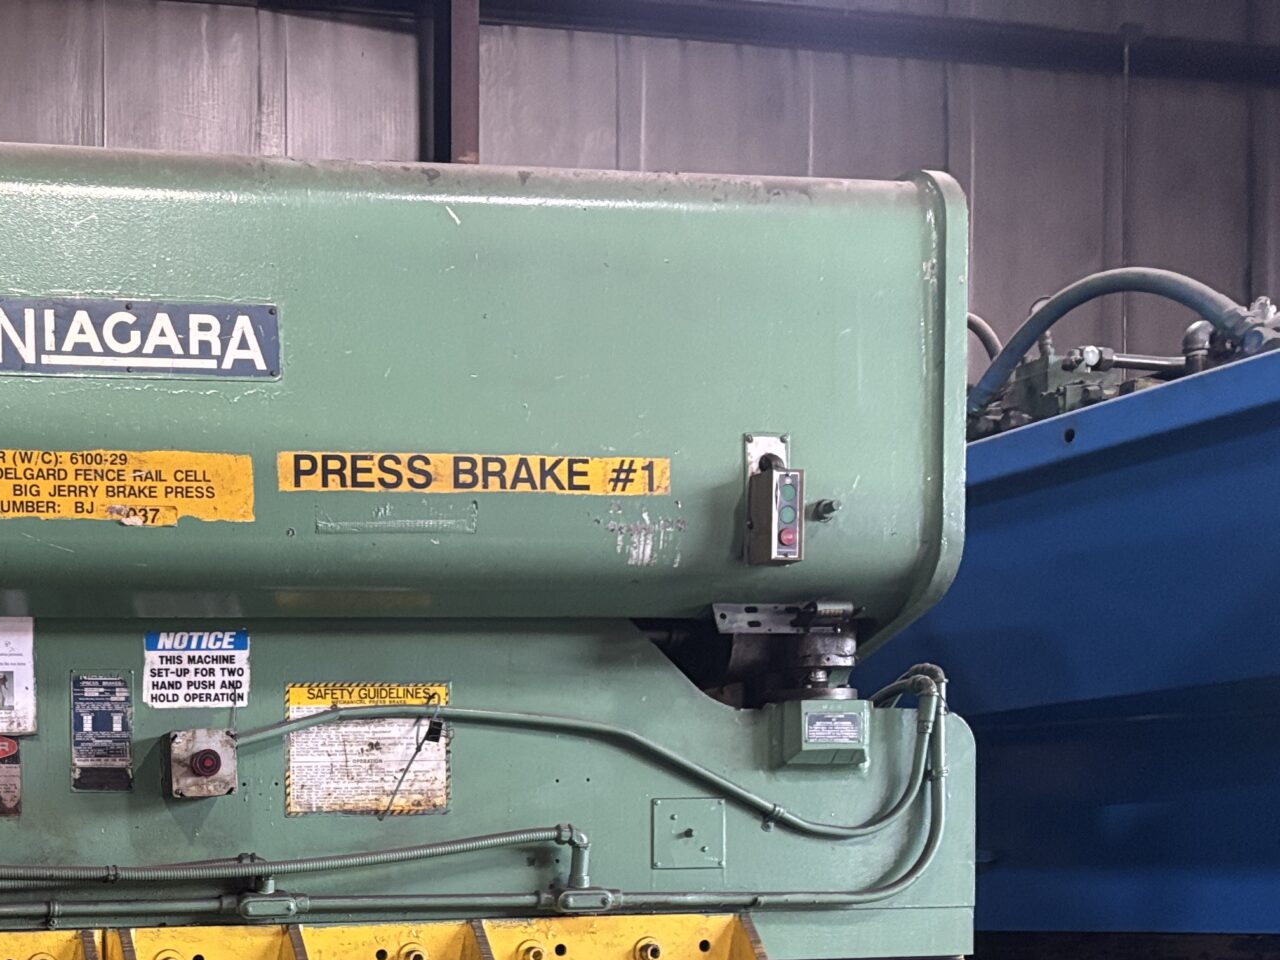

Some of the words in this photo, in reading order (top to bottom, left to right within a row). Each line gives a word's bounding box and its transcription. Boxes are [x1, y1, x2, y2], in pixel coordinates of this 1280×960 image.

[12, 451, 63, 467] (W/C):
[70, 453, 128, 466] 6100-29
[75, 469, 126, 482] FENCE
[132, 469, 167, 482] RAIL
[173, 470, 211, 483] CELL
[293, 454, 433, 490] PRESS
[453, 456, 590, 491] BRAKE
[609, 459, 656, 492] #1
[13, 484, 40, 497] BIG
[49, 485, 99, 498] JERRY
[105, 486, 157, 498] BRAKE
[164, 486, 216, 499] PRESS
[74, 501, 95, 514] BJ
[157, 631, 236, 650] NOTICE
[158, 655, 183, 665] THIS
[187, 655, 236, 665] MACHINE
[149, 668, 190, 678] SET-UP
[194, 668, 216, 677] FOR
[220, 667, 245, 677] TWO
[151, 681, 183, 690] HAND
[186, 680, 215, 690] PUSH
[220, 680, 243, 690] AND
[150, 693, 179, 703] HOLD
[183, 692, 244, 703] OPERATION
[306, 687, 354, 700] SAFETY
[357, 687, 431, 700] GUIDELINES
